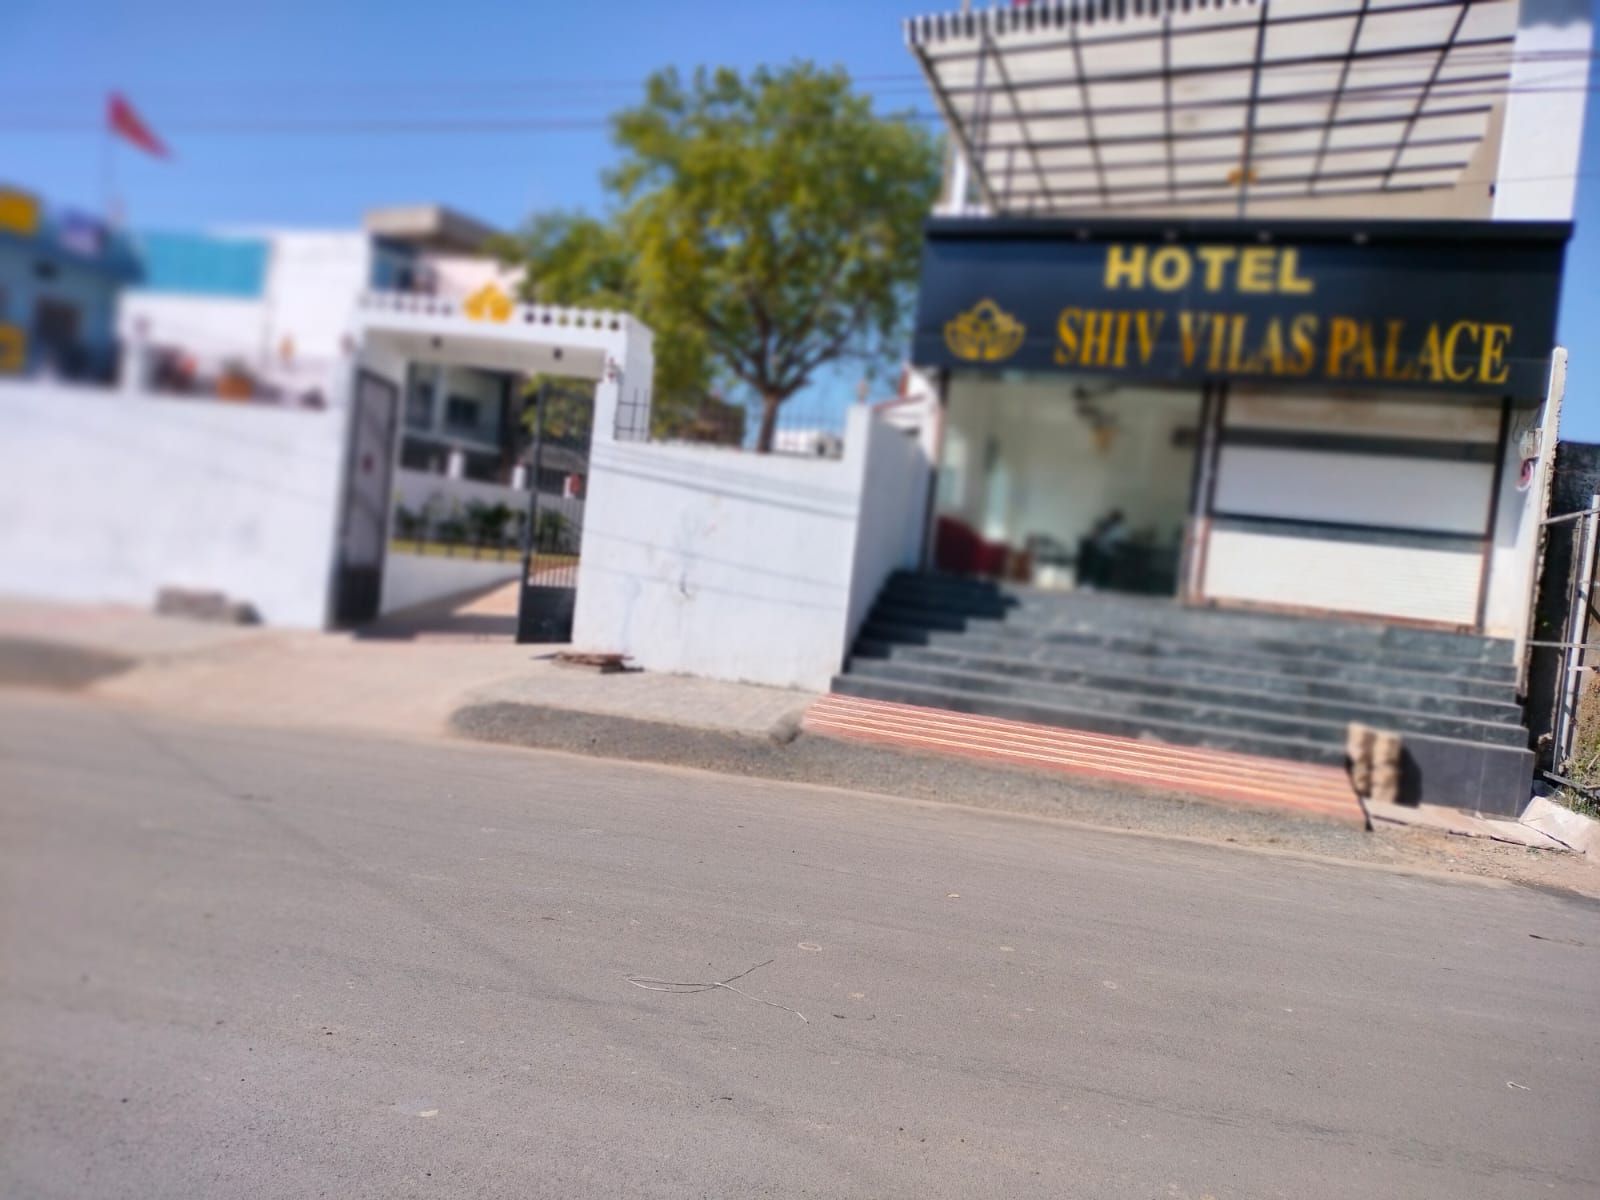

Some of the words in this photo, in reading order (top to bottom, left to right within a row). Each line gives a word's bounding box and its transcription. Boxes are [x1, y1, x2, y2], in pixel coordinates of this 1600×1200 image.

[1104, 245, 1314, 294] HOTEL
[1054, 307, 1165, 367] SHIV
[1178, 310, 1319, 376] VILAS
[1326, 316, 1512, 384] PALACE
